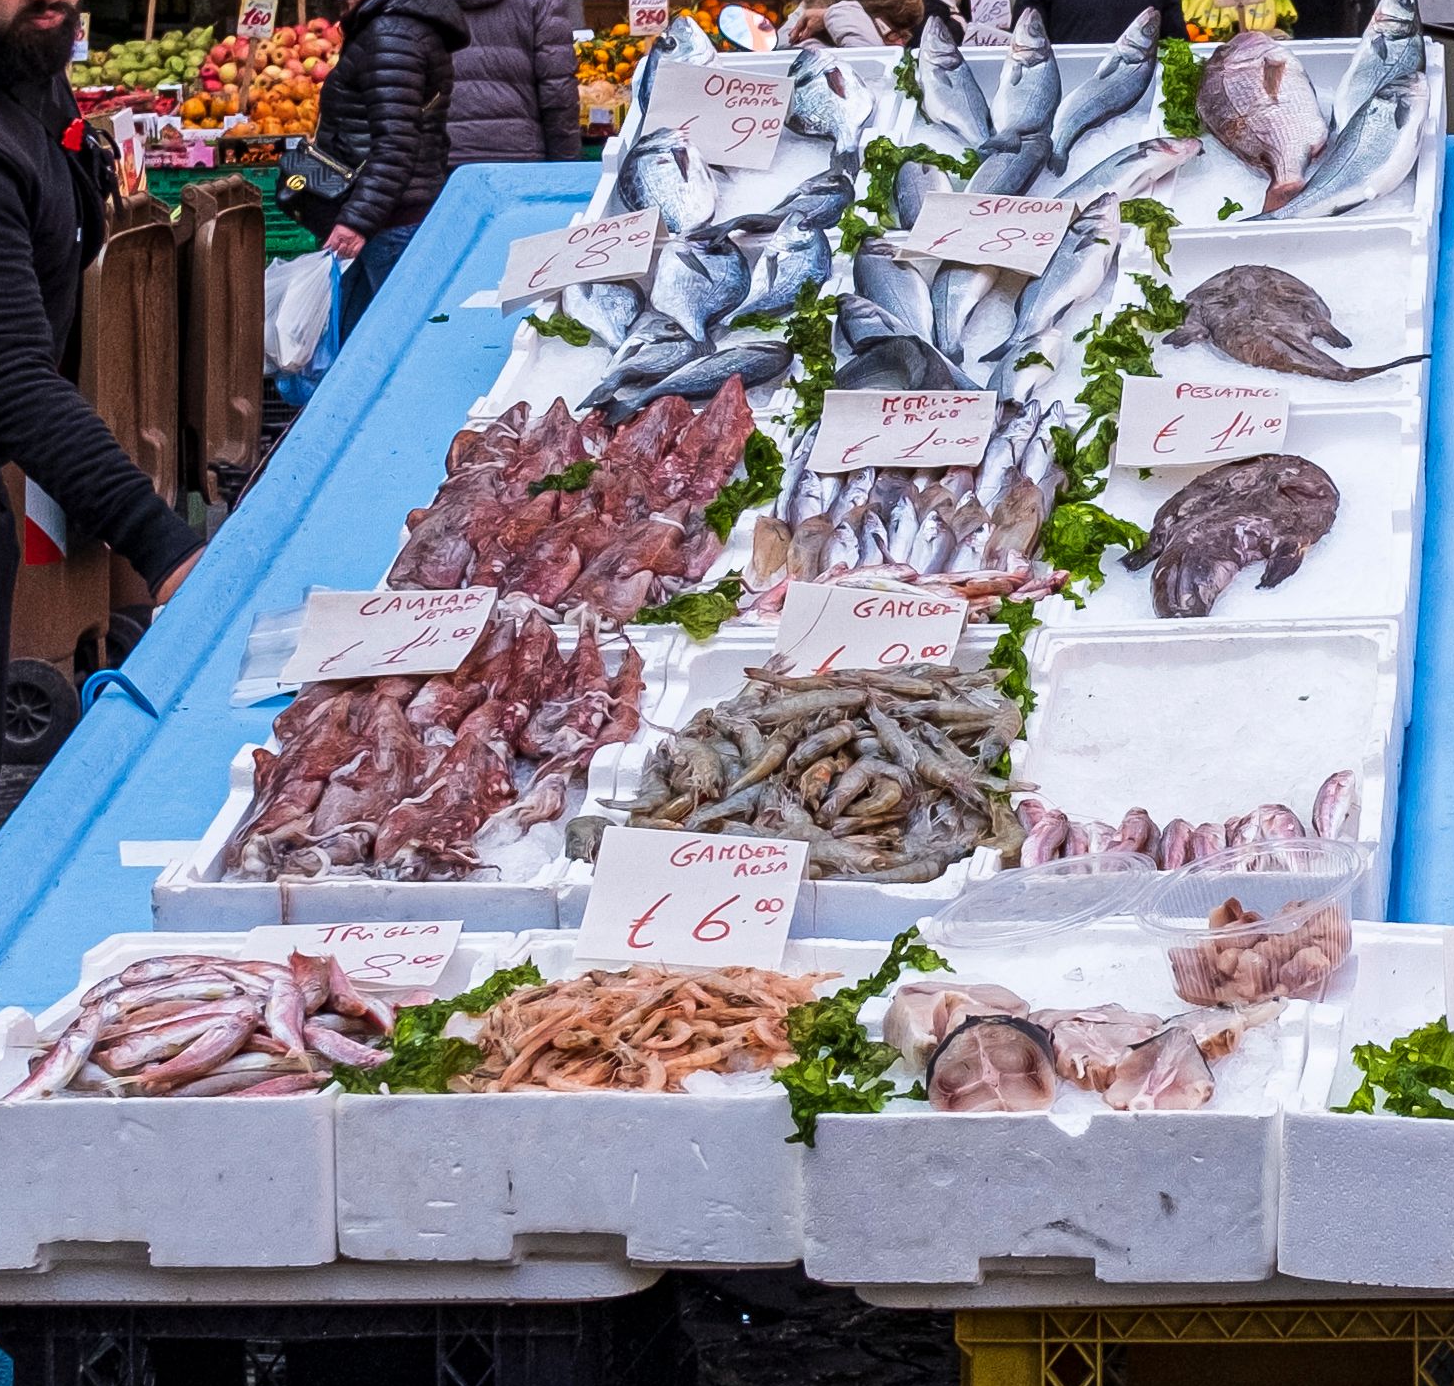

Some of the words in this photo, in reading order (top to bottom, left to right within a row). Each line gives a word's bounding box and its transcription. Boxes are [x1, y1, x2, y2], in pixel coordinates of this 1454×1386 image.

[704, 73, 779, 97] ORATE
[969, 198, 1064, 217] SPIGOLA
[568, 213, 645, 245] ORATE
[528, 252, 560, 288] €
[841, 434, 880, 465] €
[1153, 414, 1185, 454] €
[319, 640, 364, 673] €
[733, 860, 789, 878] ROSA
[316, 924, 442, 944] TRIGLIA
[626, 892, 673, 949] €
